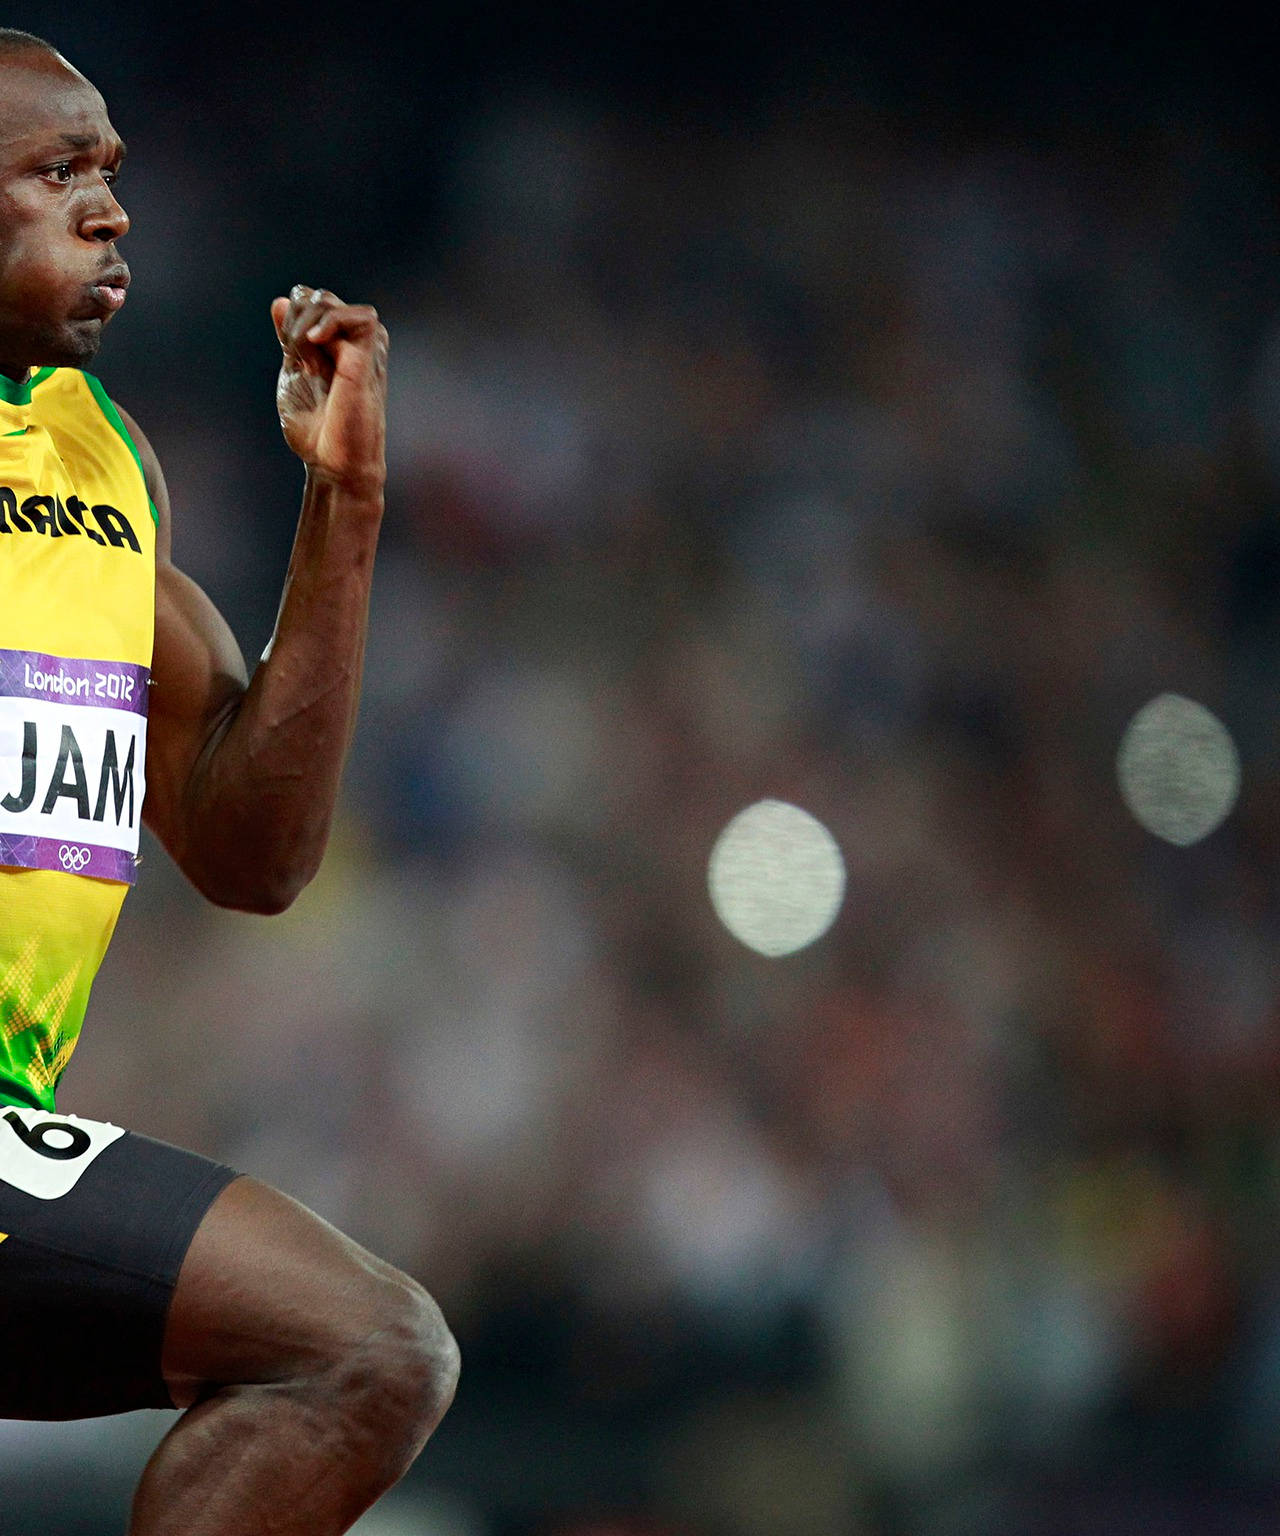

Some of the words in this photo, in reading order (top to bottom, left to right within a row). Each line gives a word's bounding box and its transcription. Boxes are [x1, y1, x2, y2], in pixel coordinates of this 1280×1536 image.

[24, 663, 90, 696] London
[94, 672, 135, 702] 2012
[0, 721, 136, 829] JAM
[2, 1111, 91, 1160] 6
